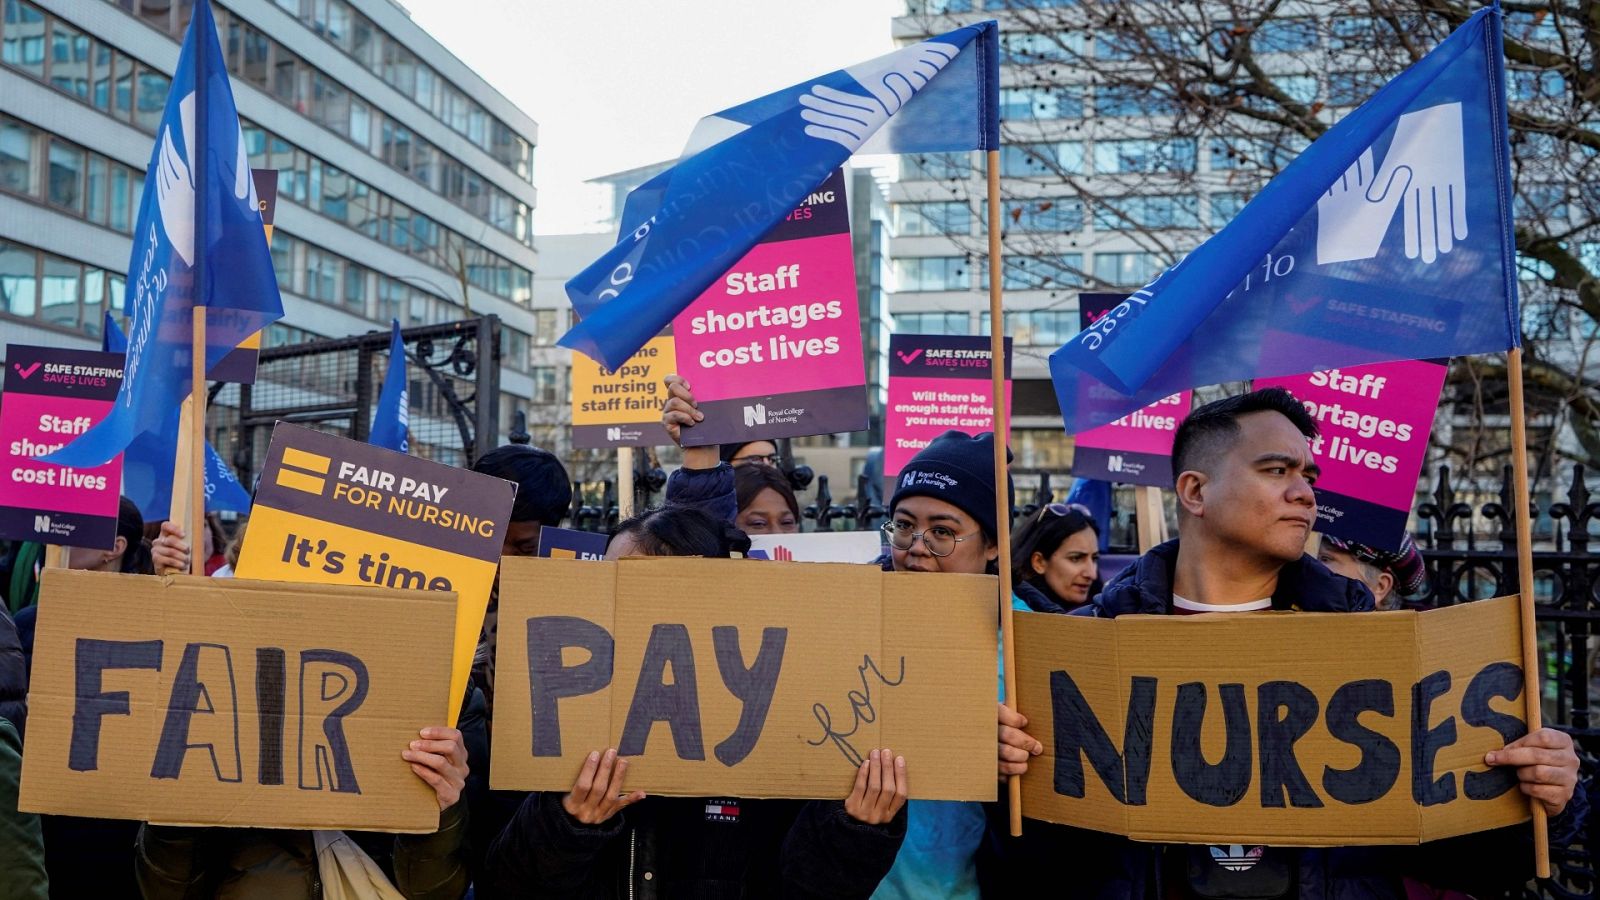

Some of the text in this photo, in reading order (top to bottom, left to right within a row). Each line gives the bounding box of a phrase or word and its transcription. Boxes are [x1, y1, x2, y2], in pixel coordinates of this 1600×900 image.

[726, 263, 801, 296] Staff
[691, 300, 842, 335] shortages
[699, 335, 840, 368] cost lives
[925, 349, 992, 359] SAFE STAFFI
[44, 363, 123, 379] SAFE STAFFING
[925, 358, 988, 368] SAVES LIVES
[621, 365, 650, 378] pay
[43, 373, 107, 387] SAVES LIVES
[593, 380, 656, 394] nursing
[1309, 369, 1386, 399] Staff
[581, 396, 667, 411] staff fairly
[912, 391, 986, 403] Will there be
[768, 408, 805, 418] Royal College
[895, 404, 993, 415] enough staff whe
[38, 414, 91, 435] Staff
[775, 416, 797, 424] Nursing
[905, 416, 991, 427] you need care?
[1131, 409, 1176, 430] lives
[1303, 400, 1413, 442] ortages
[1329, 437, 1399, 474] lives
[12, 468, 107, 491] cost lives
[338, 461, 449, 504] FAIR PAY
[923, 478, 946, 489] Nursing
[935, 472, 958, 486] College
[333, 482, 495, 538] FOR NURSING
[1324, 506, 1344, 517] College
[581, 552, 603, 561] FAI
[358, 552, 452, 592] time
[526, 616, 905, 768] PAY for
[68, 638, 370, 795] FAIR
[1049, 661, 1528, 808] NURSES
